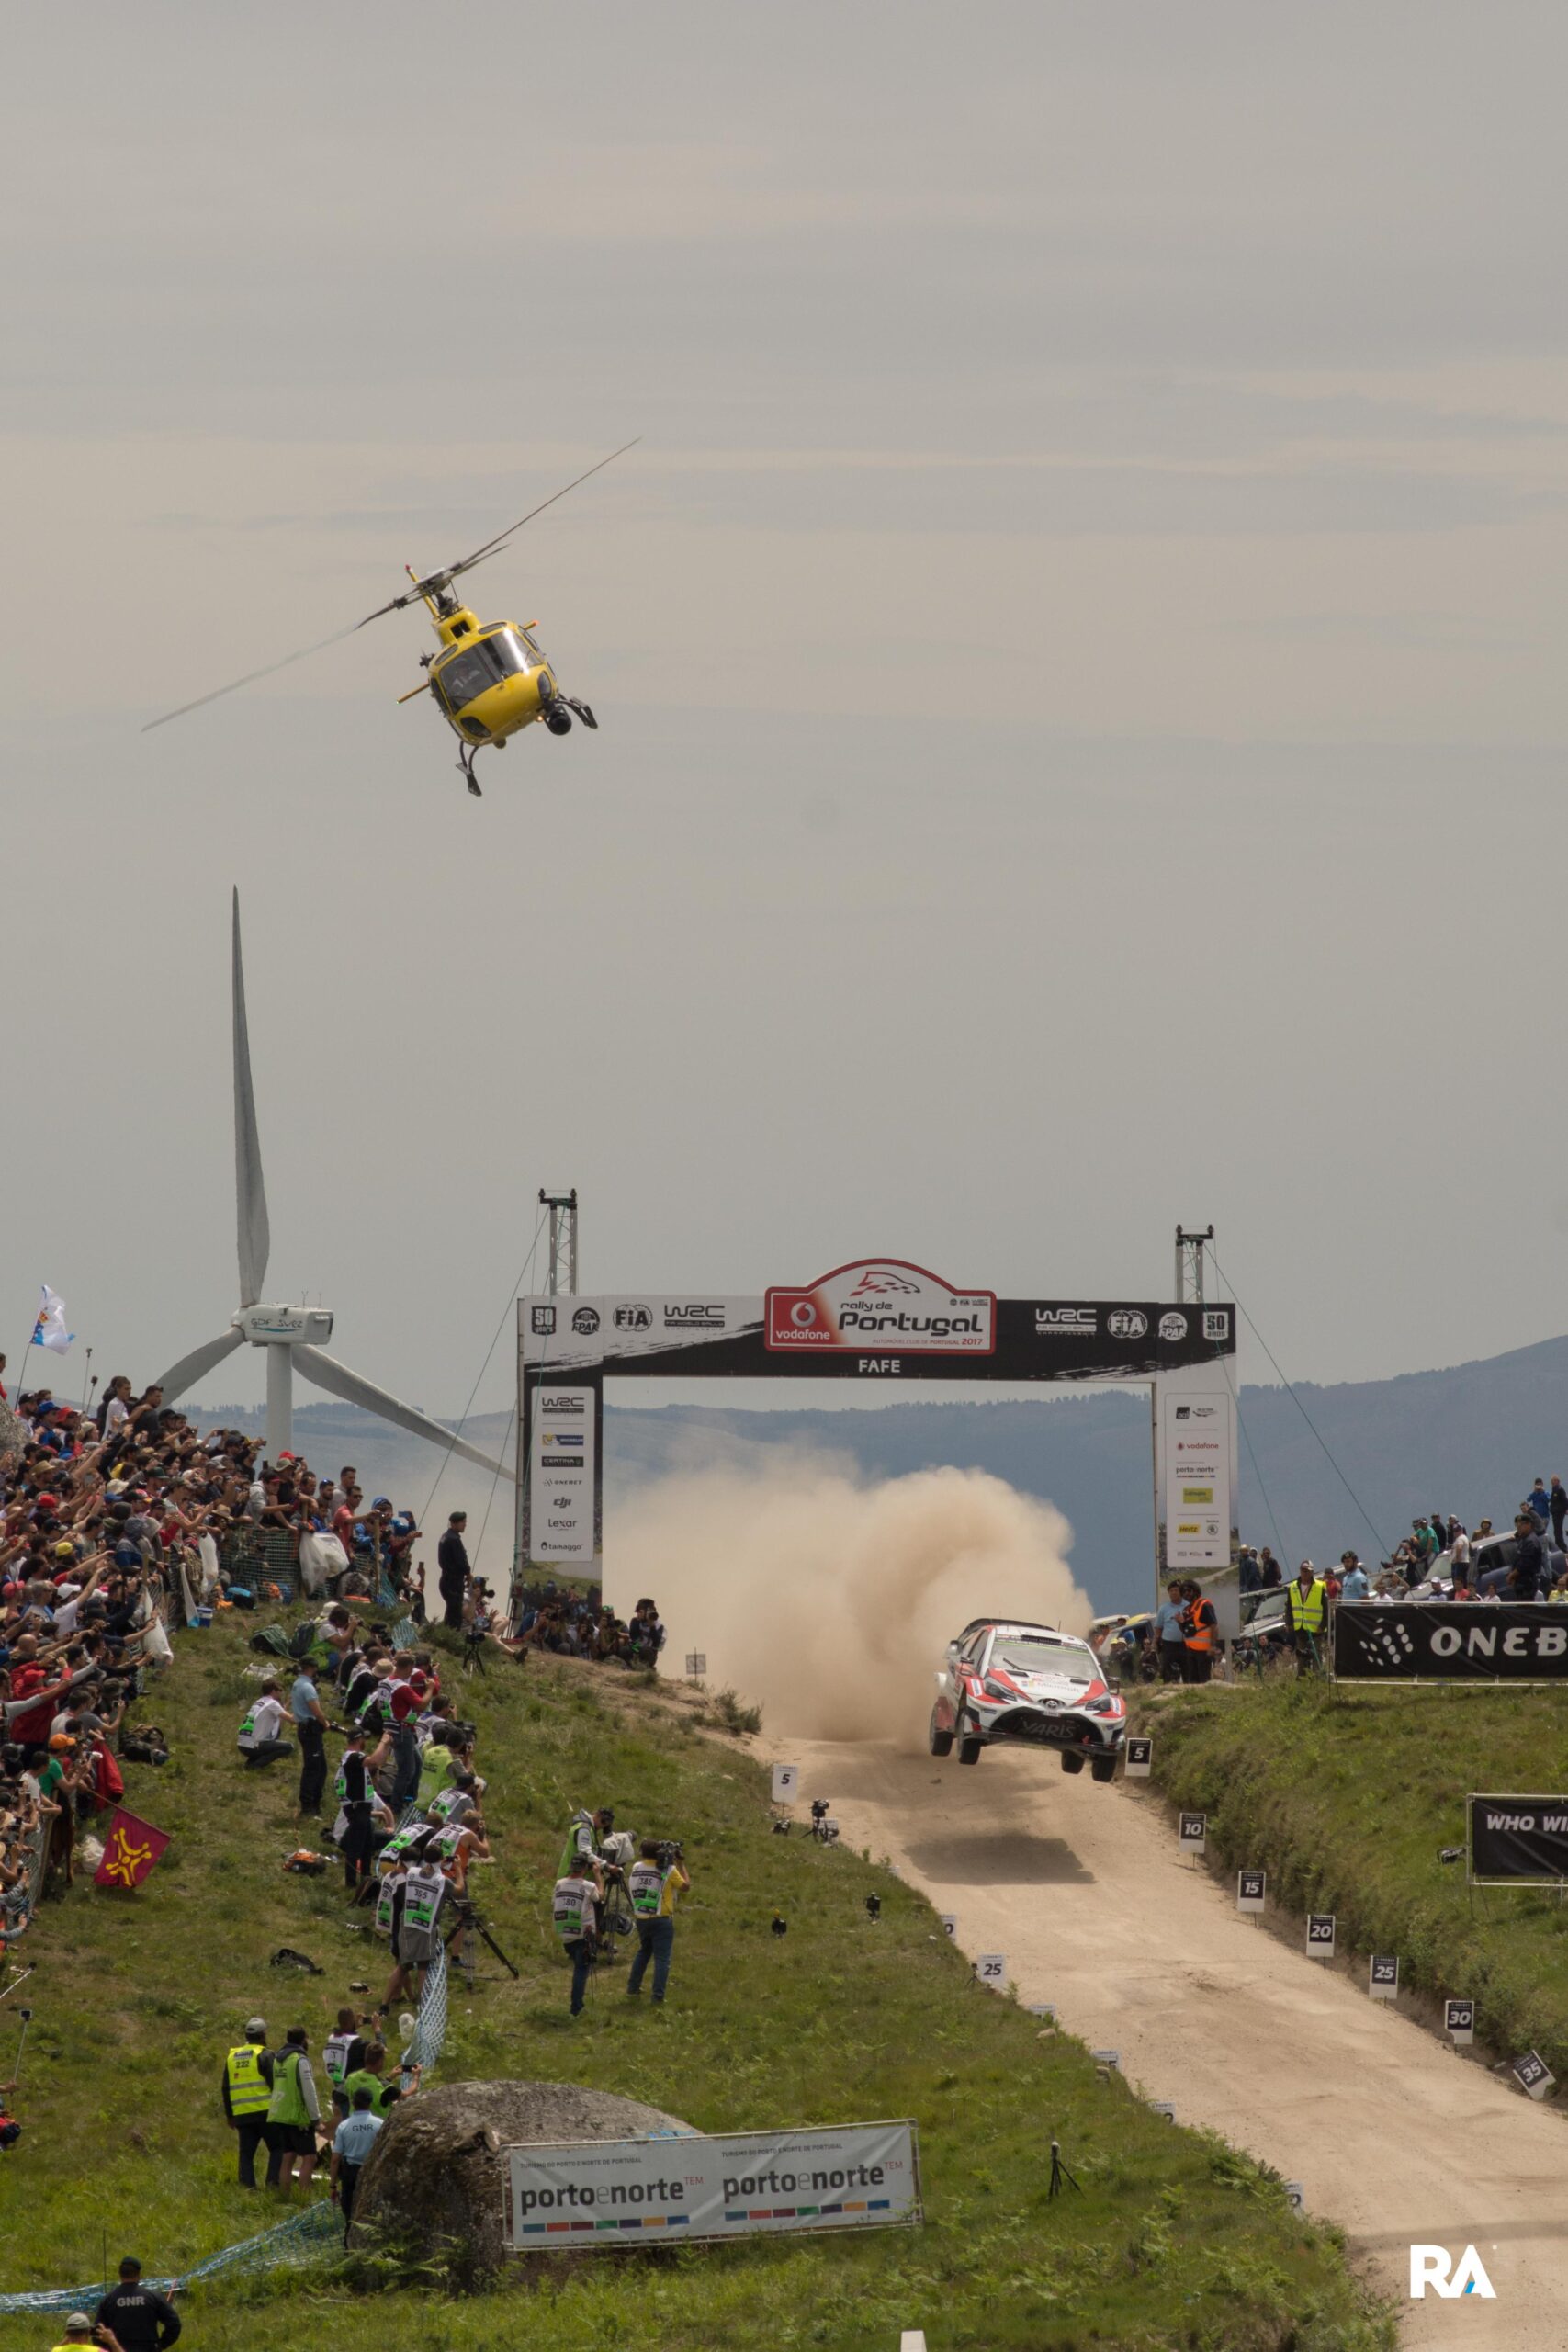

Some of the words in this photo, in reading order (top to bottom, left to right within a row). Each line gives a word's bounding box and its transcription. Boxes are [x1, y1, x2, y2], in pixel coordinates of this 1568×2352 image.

[664, 1304, 725, 1317] WRC
[840, 1301, 873, 1312] rally
[875, 1301, 893, 1310] de
[535, 1308, 554, 1326] 50
[1035, 1308, 1097, 1323] WRC
[1206, 1314, 1225, 1330] 50
[571, 1322, 599, 1332] FPAK
[838, 1312, 984, 1337] Portugal
[775, 1329, 831, 1340] vodafone
[1158, 1328, 1188, 1338] FPAK
[859, 1359, 901, 1373] FAFE
[542, 1397, 585, 1408] WRC
[547, 1518, 578, 1528] Lexar
[1179, 1525, 1199, 1533] Hertz
[548, 1544, 582, 1552] tamaggo
[1022, 1721, 1076, 1738] YARIS
[1134, 1747, 1145, 1759] 5
[781, 1773, 791, 1785] 5
[1185, 1823, 1202, 1836] 10
[1486, 1814, 1535, 1832] WHO
[1245, 1882, 1259, 1894] 15
[1311, 1925, 1332, 1939] 20
[983, 1963, 1002, 1976] 25
[1374, 1965, 1394, 1979] 25
[1449, 2010, 1472, 2025] 30
[1522, 2061, 1542, 2083] 35
[352, 2123, 374, 2132] GNR
[612, 2156, 643, 2165] PORTUGAL
[722, 2150, 748, 2158] TURISMO
[723, 2164, 884, 2204] portoenorte
[885, 2160, 903, 2169] TEM
[521, 2177, 684, 2216] portoenorte
[683, 2176, 705, 2186] TEM
[117, 2296, 145, 2307] GNR
